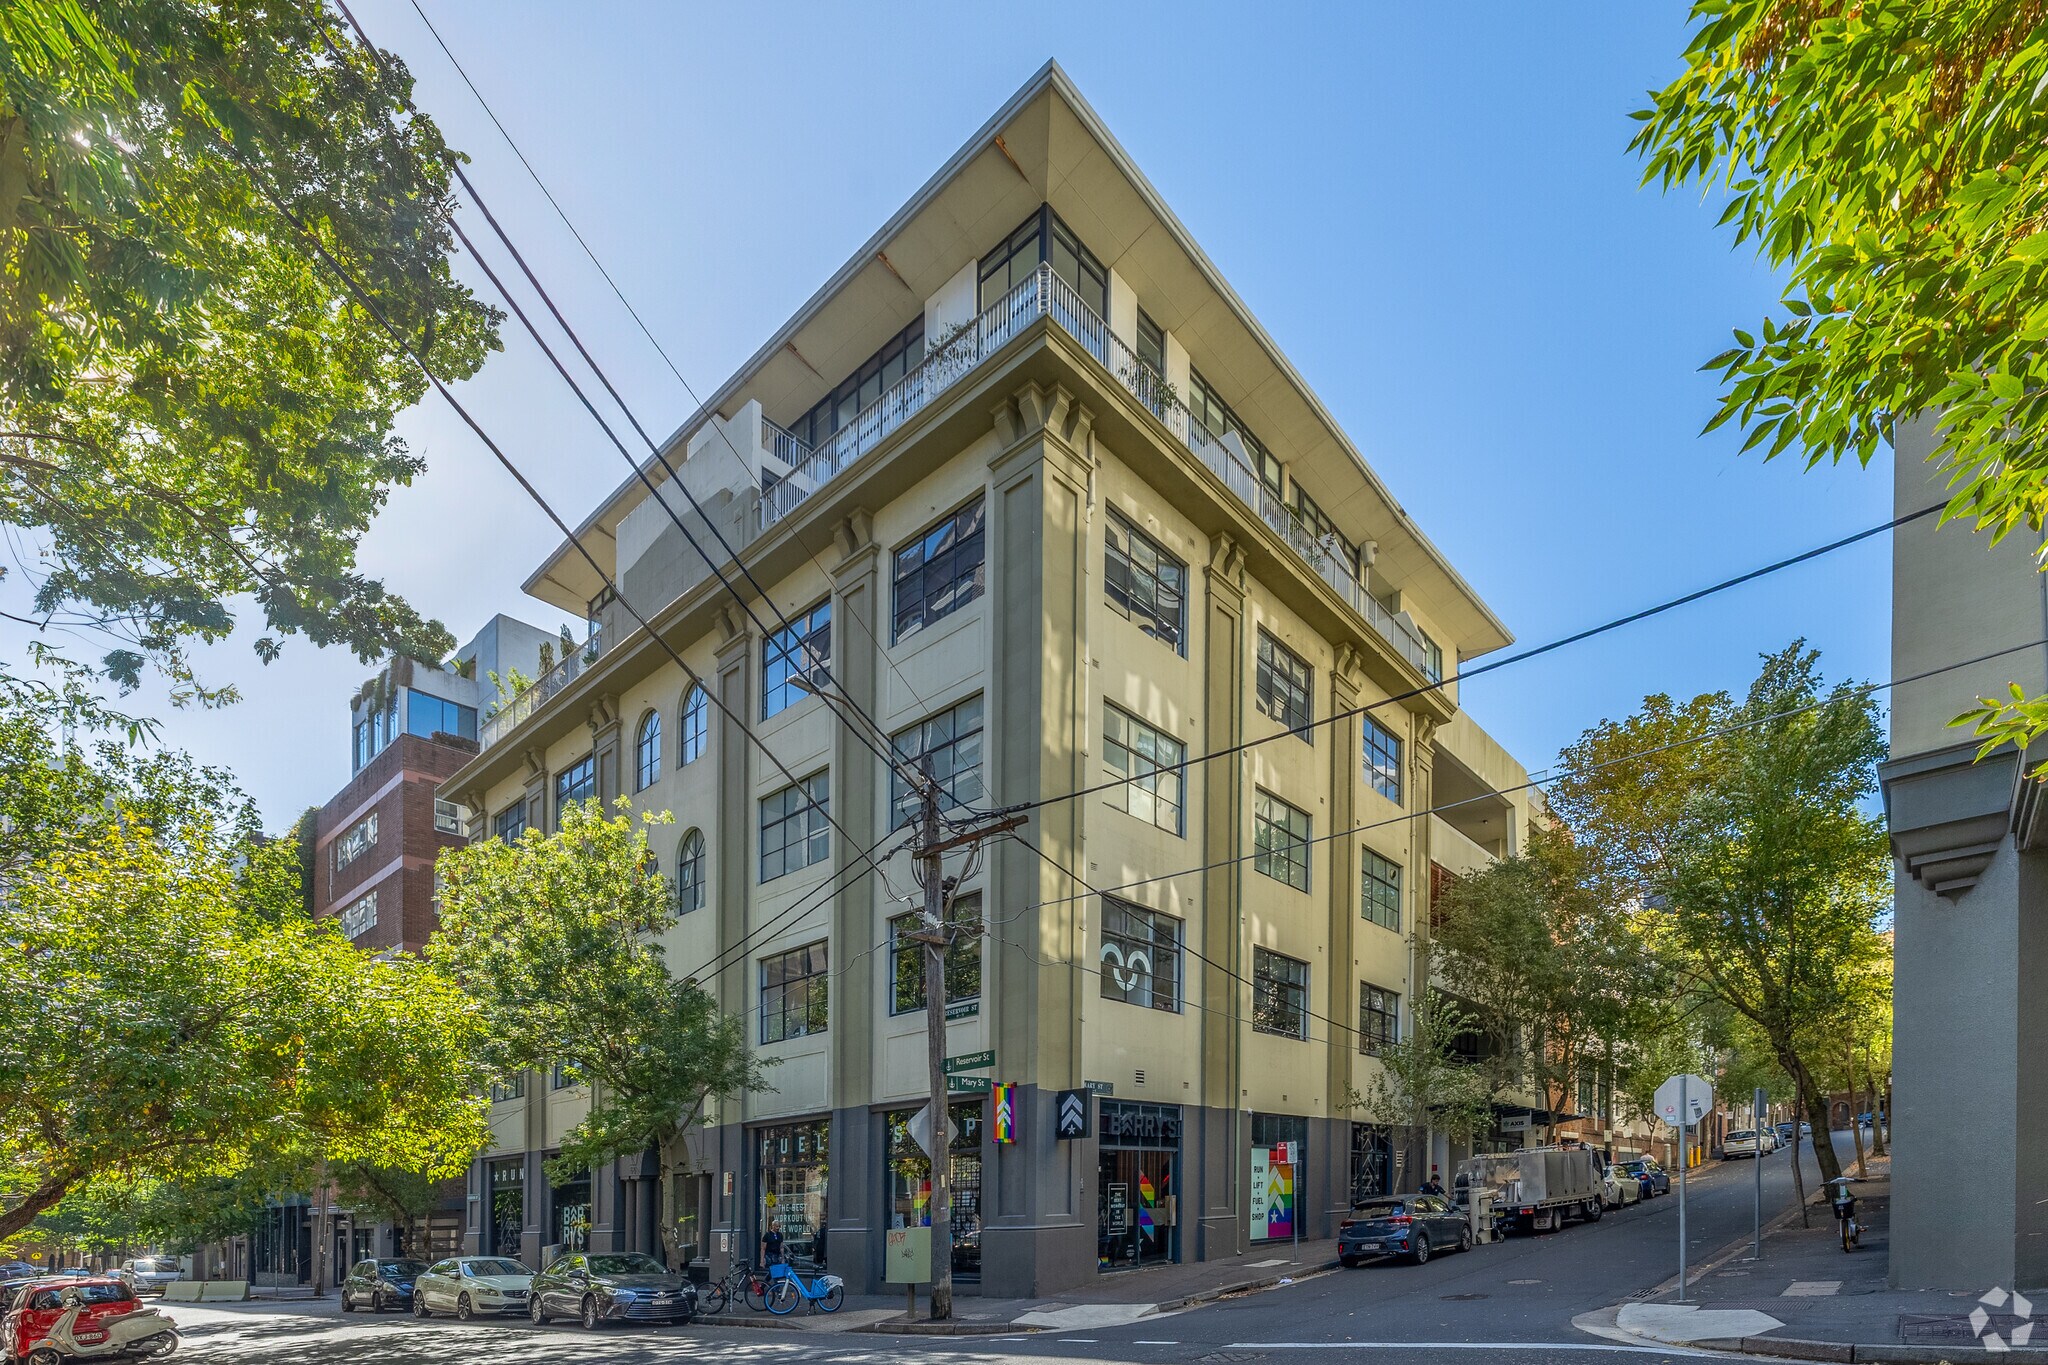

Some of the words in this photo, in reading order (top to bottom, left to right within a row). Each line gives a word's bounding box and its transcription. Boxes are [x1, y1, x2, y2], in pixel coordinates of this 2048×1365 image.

[956, 1054, 982, 1066] Reservoir
[962, 1078, 977, 1088] Mary
[764, 1135, 824, 1156] FUEL
[502, 1168, 524, 1181] RUN
[778, 1204, 790, 1212] THE
[774, 1214, 803, 1222] WORKOUT
[788, 1224, 810, 1232] WORLD
